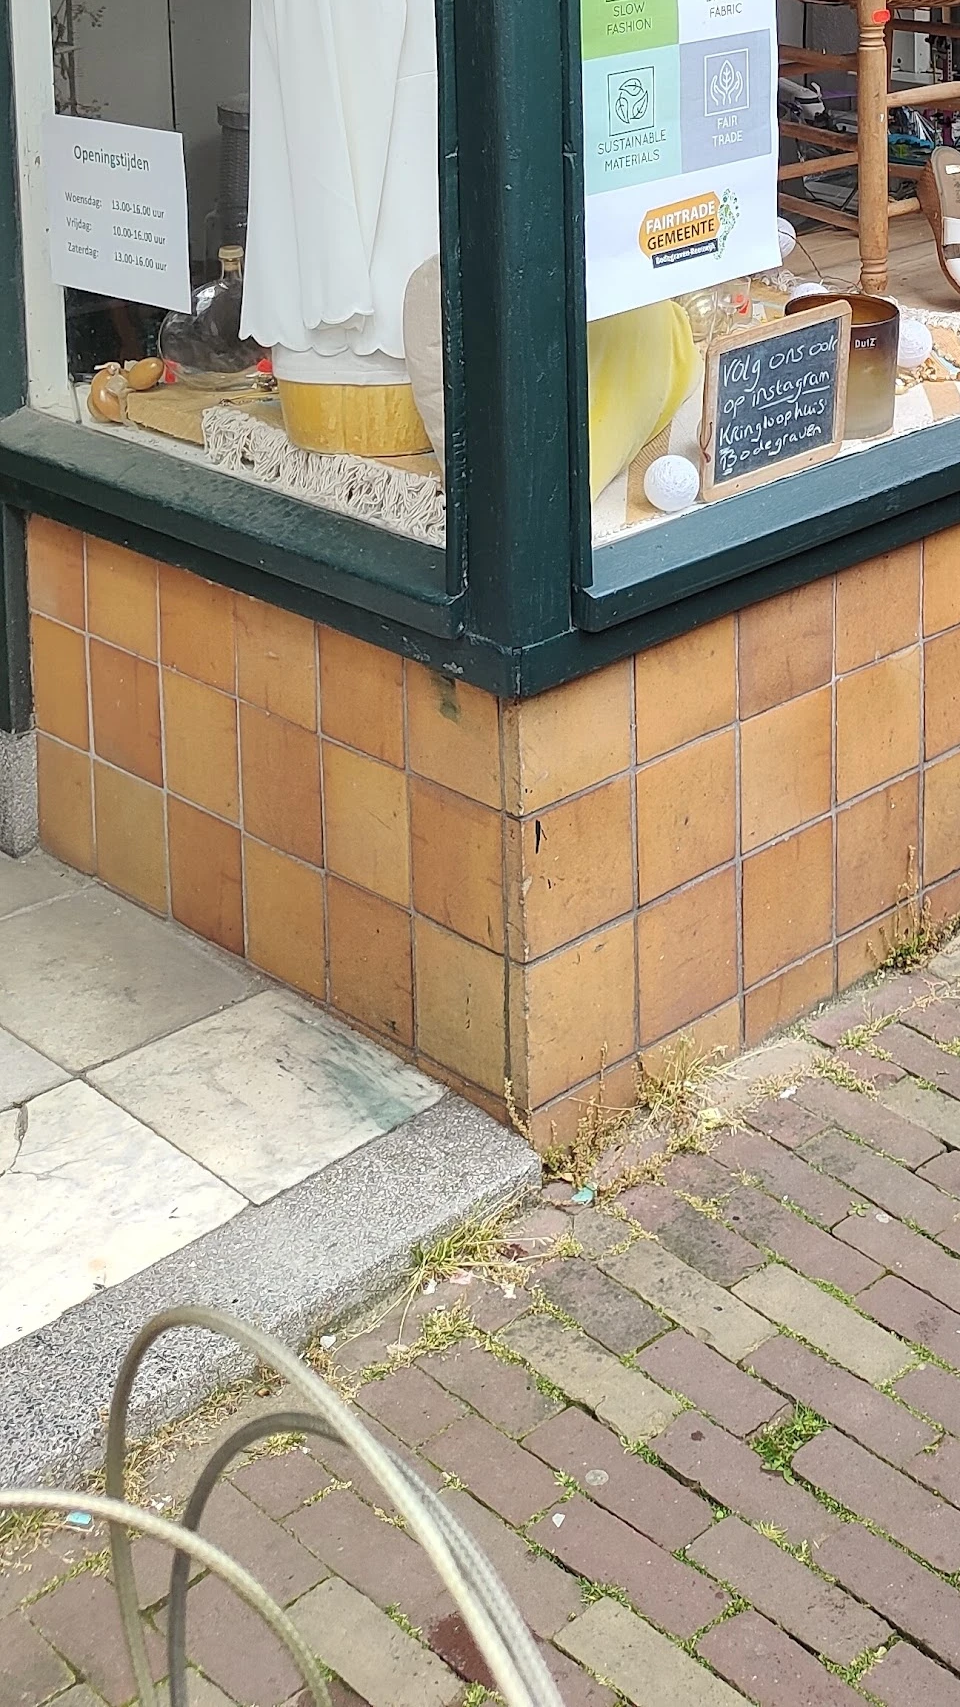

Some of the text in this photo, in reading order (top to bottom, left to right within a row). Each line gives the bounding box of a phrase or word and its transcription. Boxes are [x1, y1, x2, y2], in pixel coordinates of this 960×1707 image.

[613, 2, 645, 18] SLOW
[709, 3, 743, 18] FABRIC
[606, 18, 652, 36] FASHION
[717, 115, 738, 129] FAIR
[597, 129, 667, 155] SUSTAINABLE
[712, 130, 743, 148] TRADE
[73, 145, 150, 172] Openingstijden
[604, 149, 660, 172] MATERIALS
[65, 191, 165, 219] Woensdag: 13.00-16.00 uur
[646, 200, 716, 235] FAIRTRADE
[66, 217, 166, 245] Vrijdag: 10.00-16.00 uur
[647, 218, 715, 251] GEMEENTE
[67, 242, 167, 272] Zaterdag: 13.00-16.00 uur
[723, 335, 839, 392] Volg ons ook
[724, 369, 830, 419] op instagram
[719, 423, 822, 472] Bodegraven
